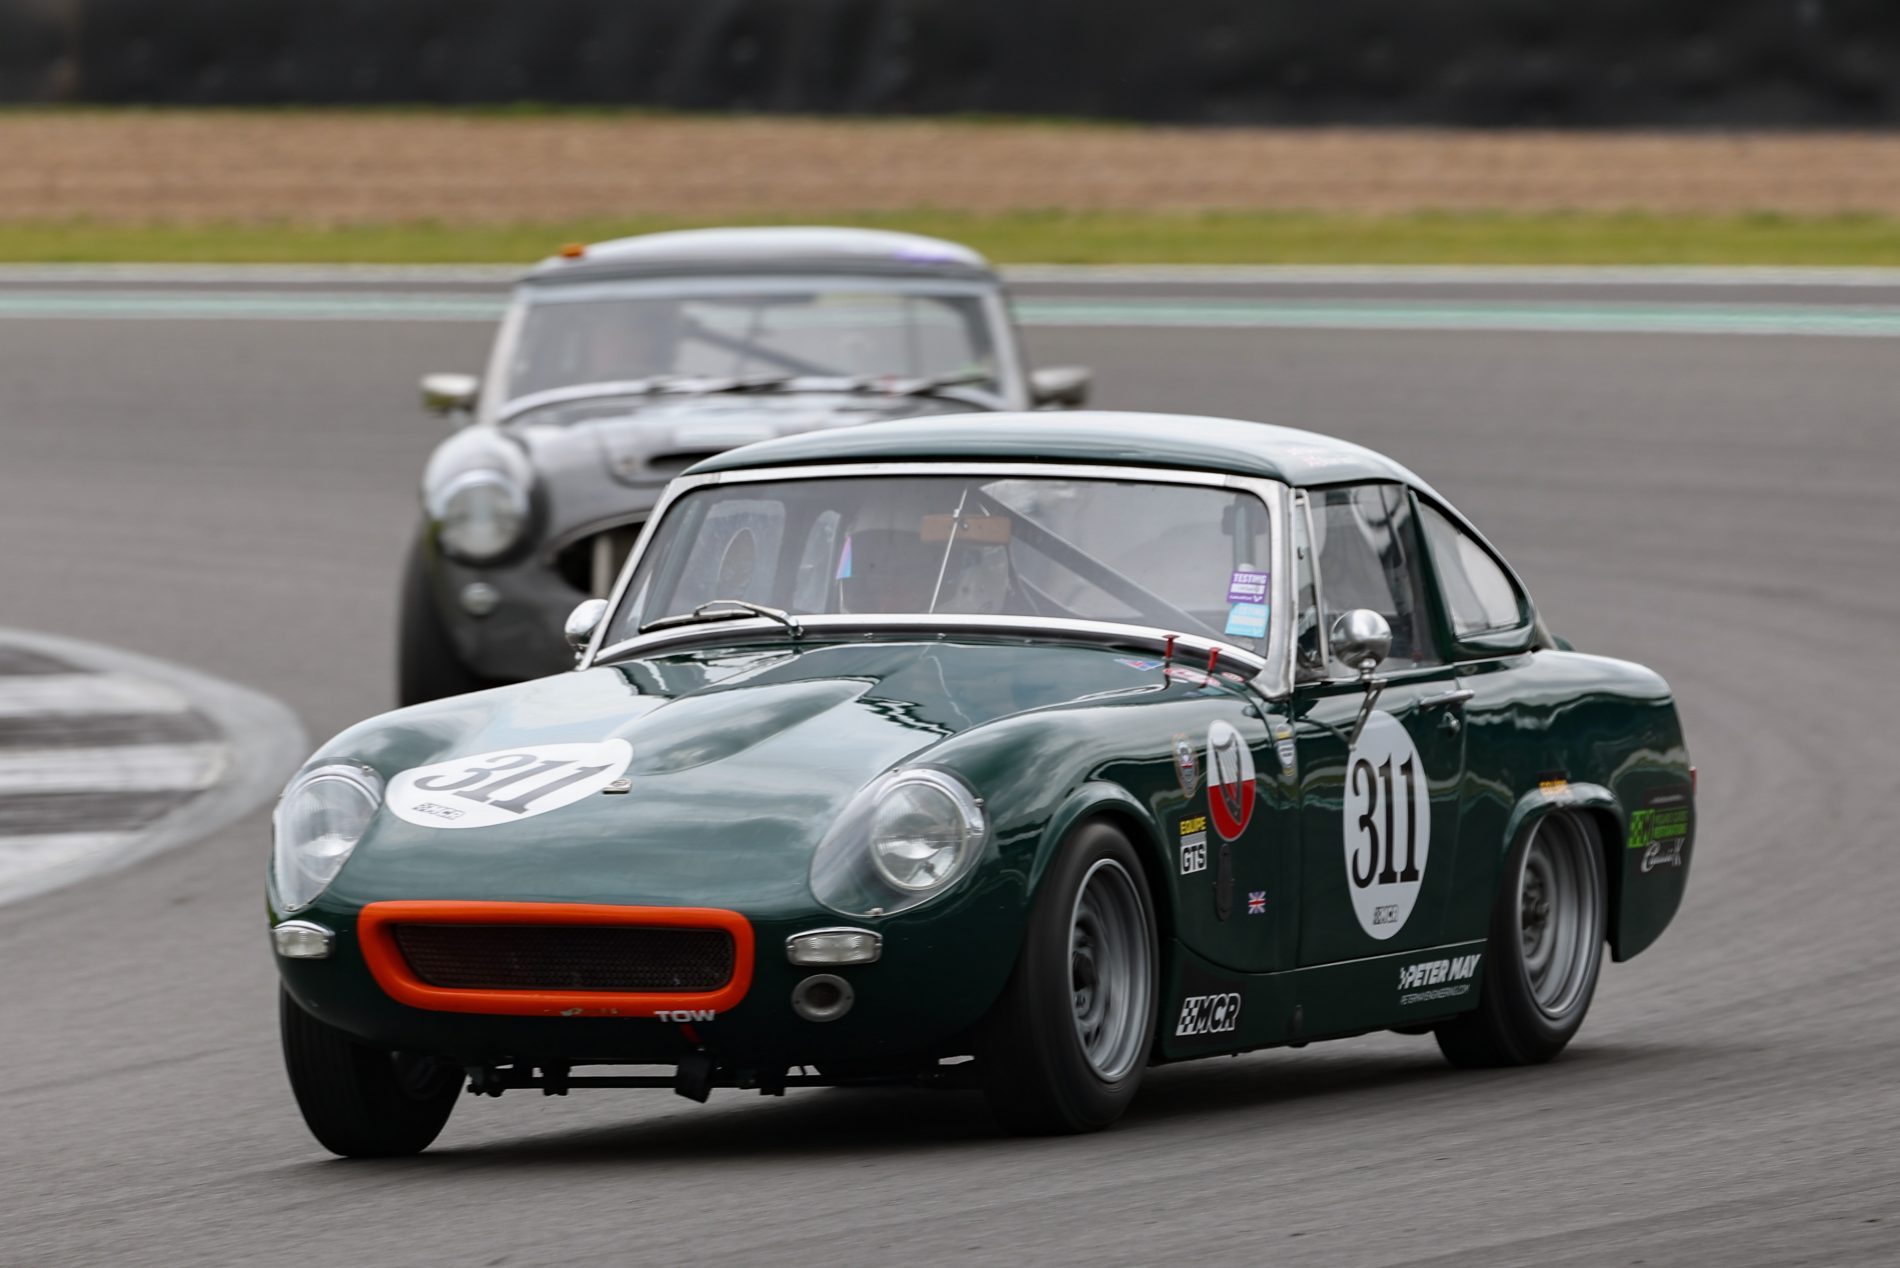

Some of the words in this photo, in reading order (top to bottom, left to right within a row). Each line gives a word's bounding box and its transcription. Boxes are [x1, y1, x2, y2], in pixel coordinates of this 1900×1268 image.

[413, 753, 615, 815] 311
[1352, 752, 1420, 889] 311
[1183, 843, 1206, 872] GTS
[1403, 959, 1450, 989] PETER
[1447, 953, 1482, 981] MAY
[653, 1009, 716, 1022] TOW
[1189, 992, 1242, 1034] MCR
